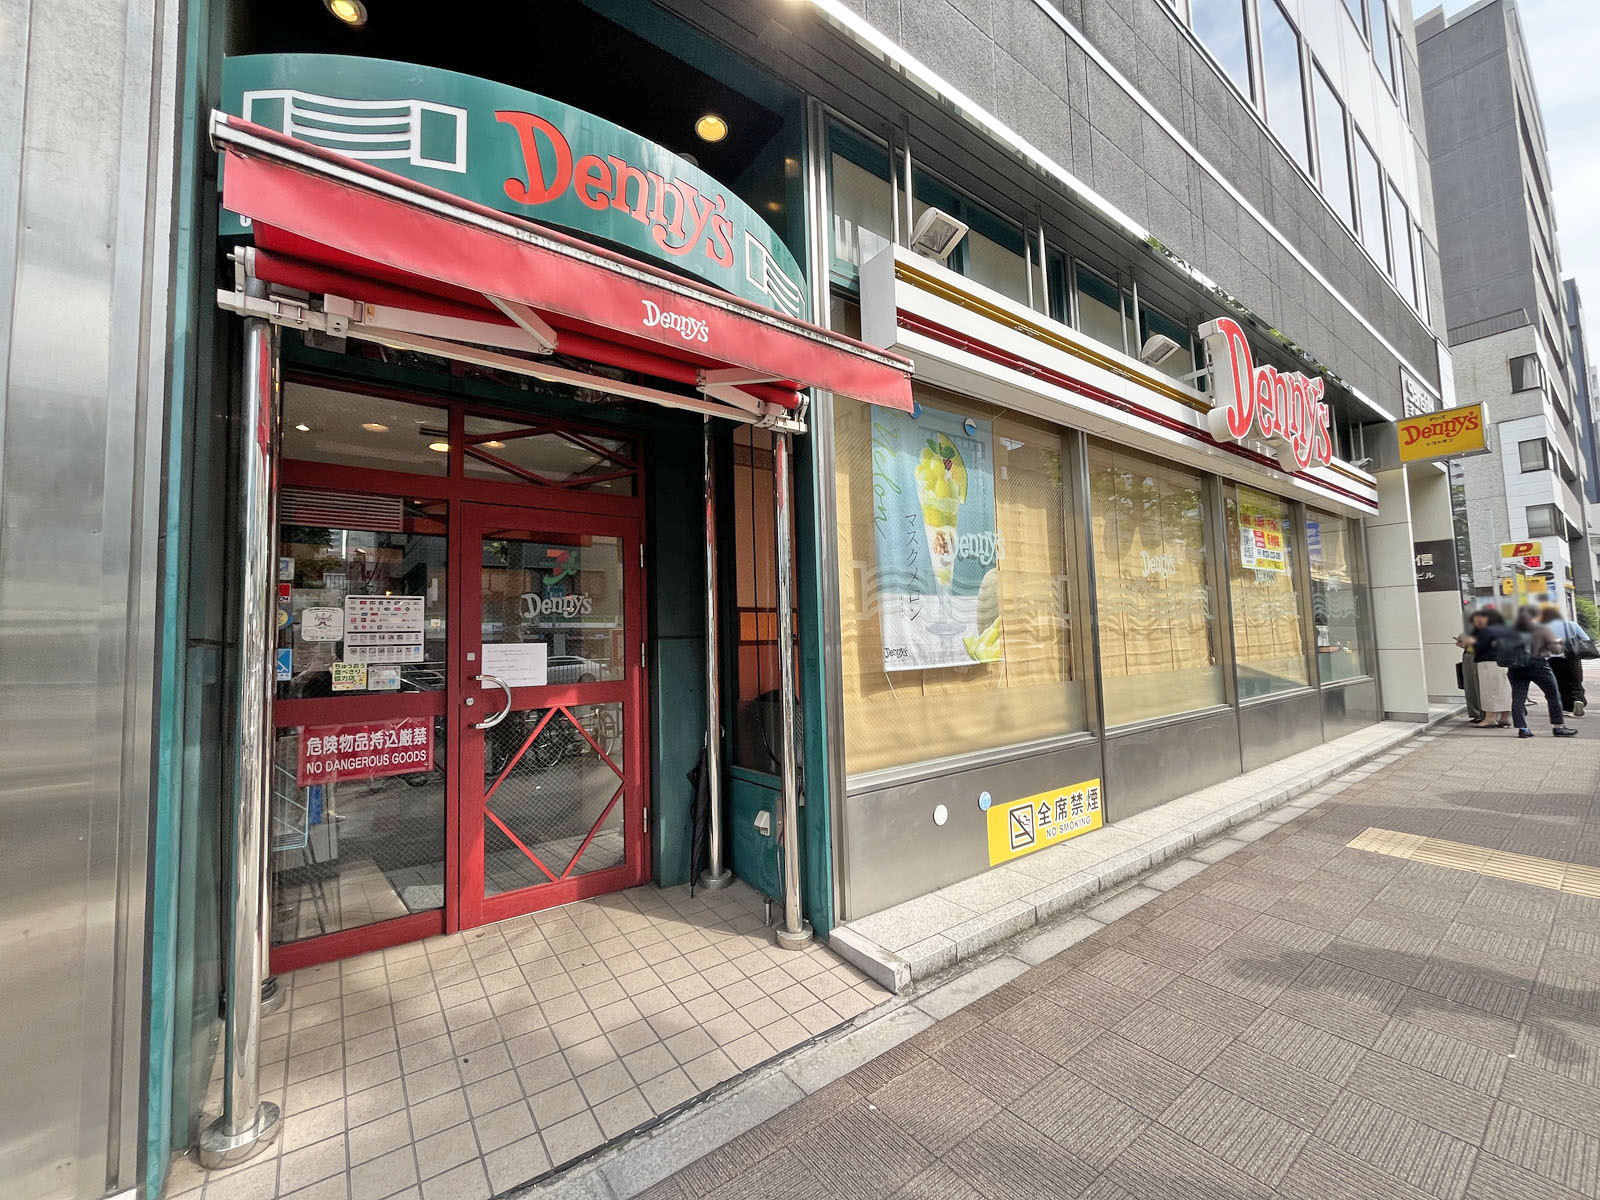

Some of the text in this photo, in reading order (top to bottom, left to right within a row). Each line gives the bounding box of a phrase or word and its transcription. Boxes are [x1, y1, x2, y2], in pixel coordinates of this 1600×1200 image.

[494, 110, 734, 268] Denny's
[642, 300, 709, 343] Denny's
[1216, 316, 1334, 471] Denny's
[1401, 411, 1479, 446] Denny's
[905, 514, 922, 621] マスクメロン
[521, 592, 592, 619] Denny's
[884, 647, 908, 659] Denny's
[306, 727, 427, 756] 危険物品持込厳禁
[306, 750, 427, 774] NO DANGEROUS GOODS
[1037, 788, 1099, 828] 全席禁煙
[1046, 816, 1091, 838] NO SMOKING
